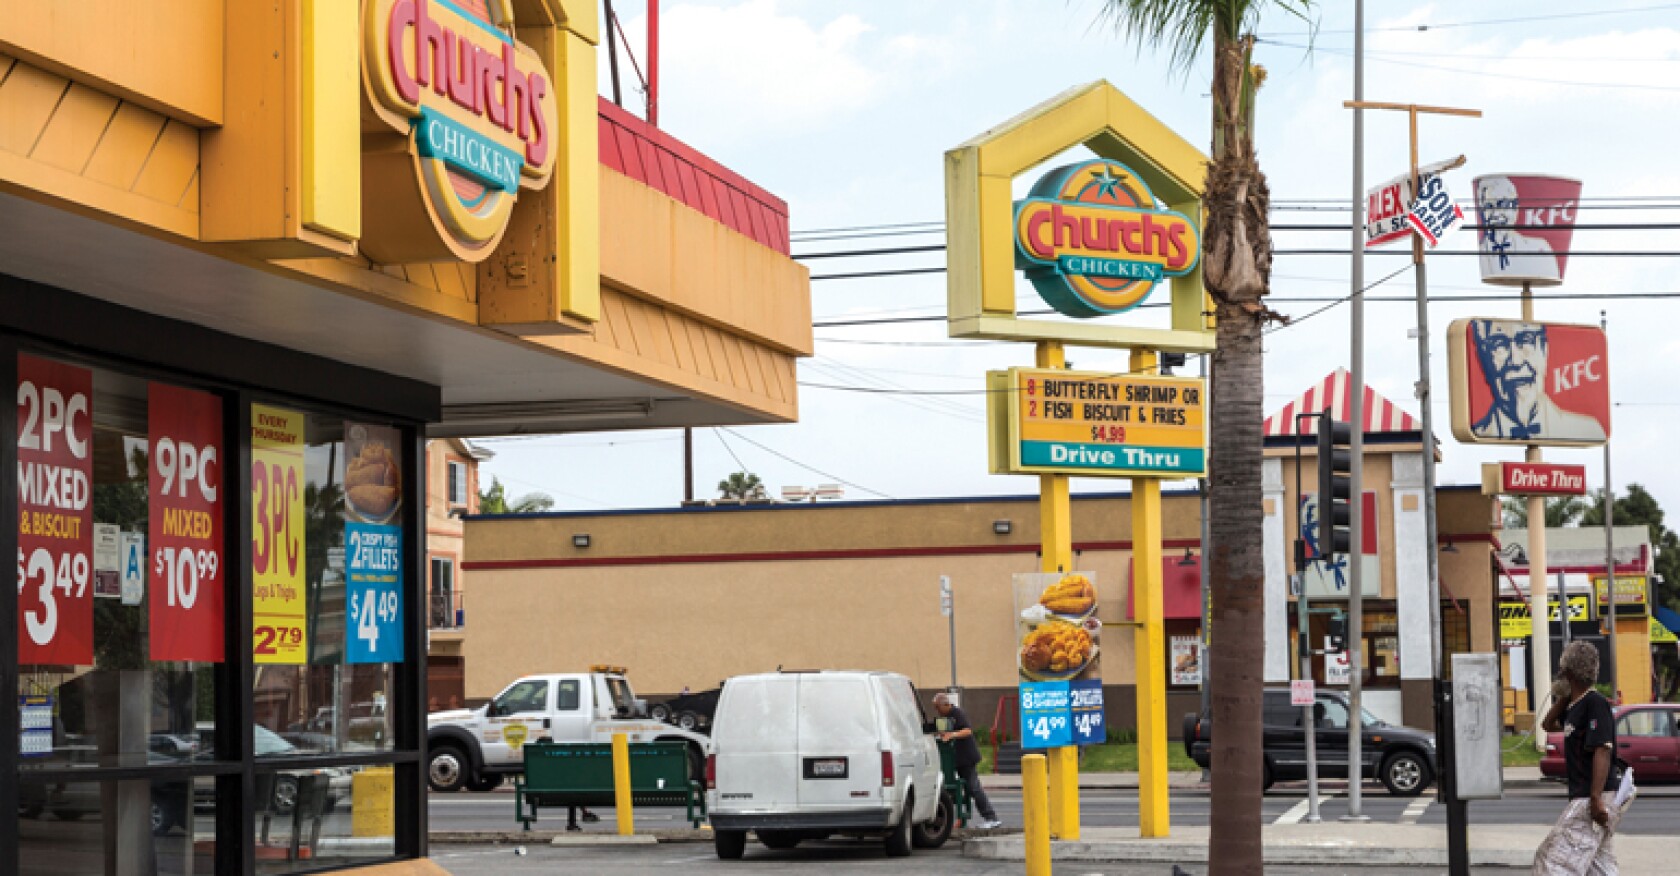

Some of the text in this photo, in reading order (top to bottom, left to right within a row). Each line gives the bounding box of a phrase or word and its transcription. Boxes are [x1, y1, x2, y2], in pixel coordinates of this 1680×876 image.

[429, 119, 517, 186] CHICKEN
[1368, 182, 1404, 225] ALEX
[1524, 200, 1574, 226] KFC
[1066, 257, 1156, 279] CHICKEN
[1553, 355, 1600, 394] KFC
[1027, 378, 1199, 405] 8 BUTTERFLY SHRIMP OR
[17, 380, 88, 460] 2PC
[257, 413, 288, 428] EVERY
[1029, 400, 1187, 425] 2 FISH BISCUIT & FRIES
[251, 427, 298, 444] THURSDAY
[1091, 425, 1126, 443] $4.99
[155, 436, 217, 503] 9PC
[1051, 445, 1180, 468] Drive Thru
[17, 460, 89, 511] MIXED
[1511, 467, 1583, 489] Drive Thru
[21, 510, 31, 535] &
[33, 511, 81, 540] BISCUIT
[162, 507, 213, 540] MIXED
[251, 459, 299, 578] 3PC
[126, 544, 140, 580] A
[349, 530, 361, 570] 2
[361, 547, 399, 571] FILLETS
